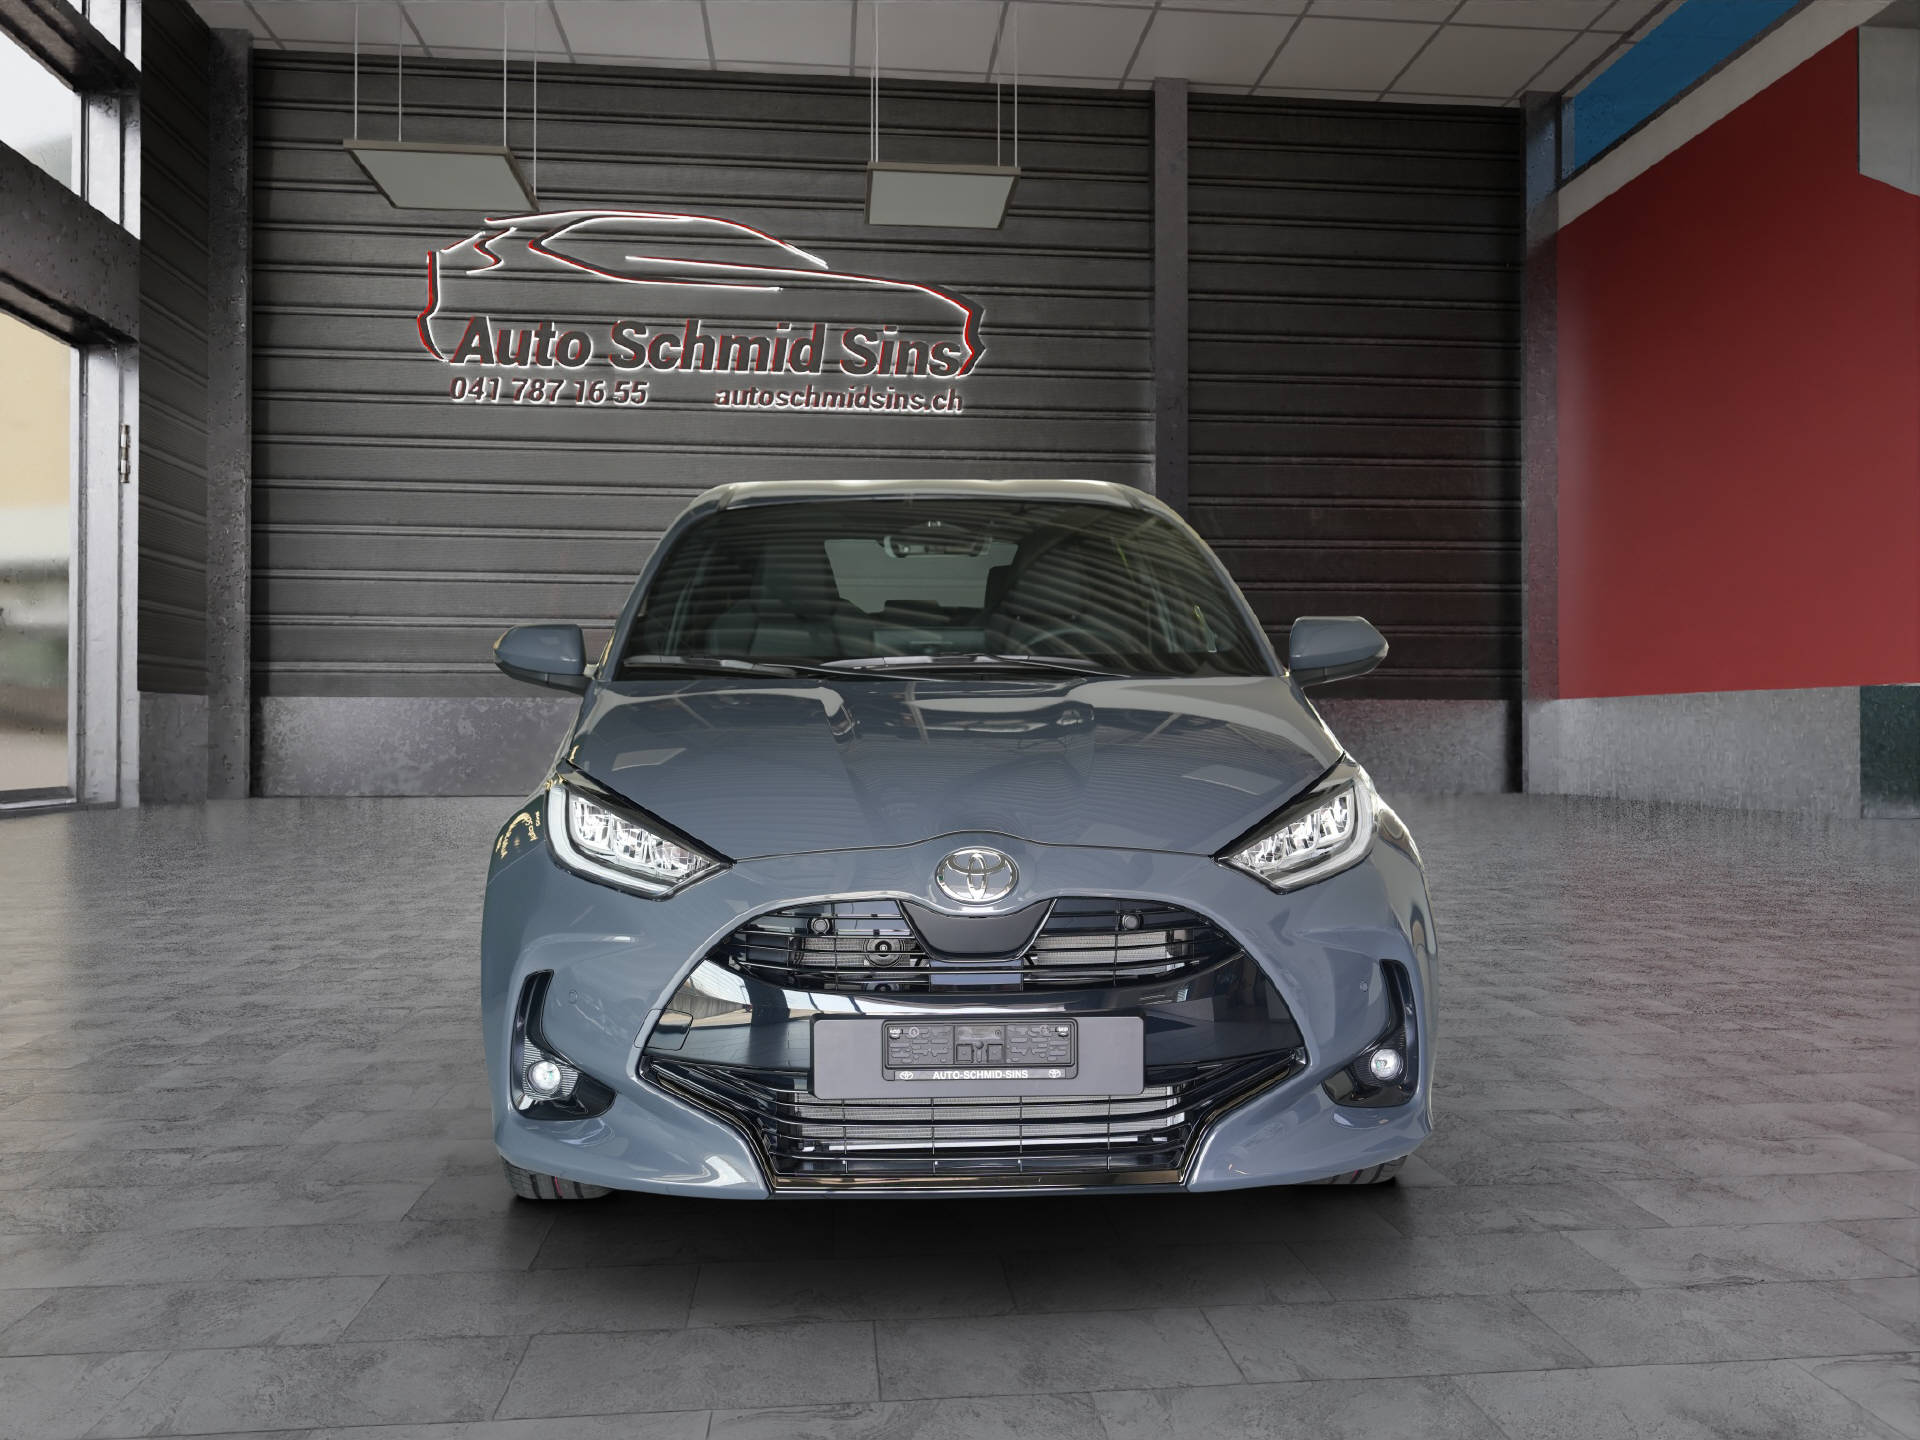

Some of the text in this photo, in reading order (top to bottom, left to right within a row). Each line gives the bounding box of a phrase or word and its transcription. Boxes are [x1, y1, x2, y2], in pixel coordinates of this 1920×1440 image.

[450, 315, 963, 378] Auto Schmid Sins
[450, 376, 650, 406] 041 787 16 55
[715, 384, 963, 413] autoschmidsins.ch
[932, 1069, 1029, 1080] AUTO-SCHMID-SINS
